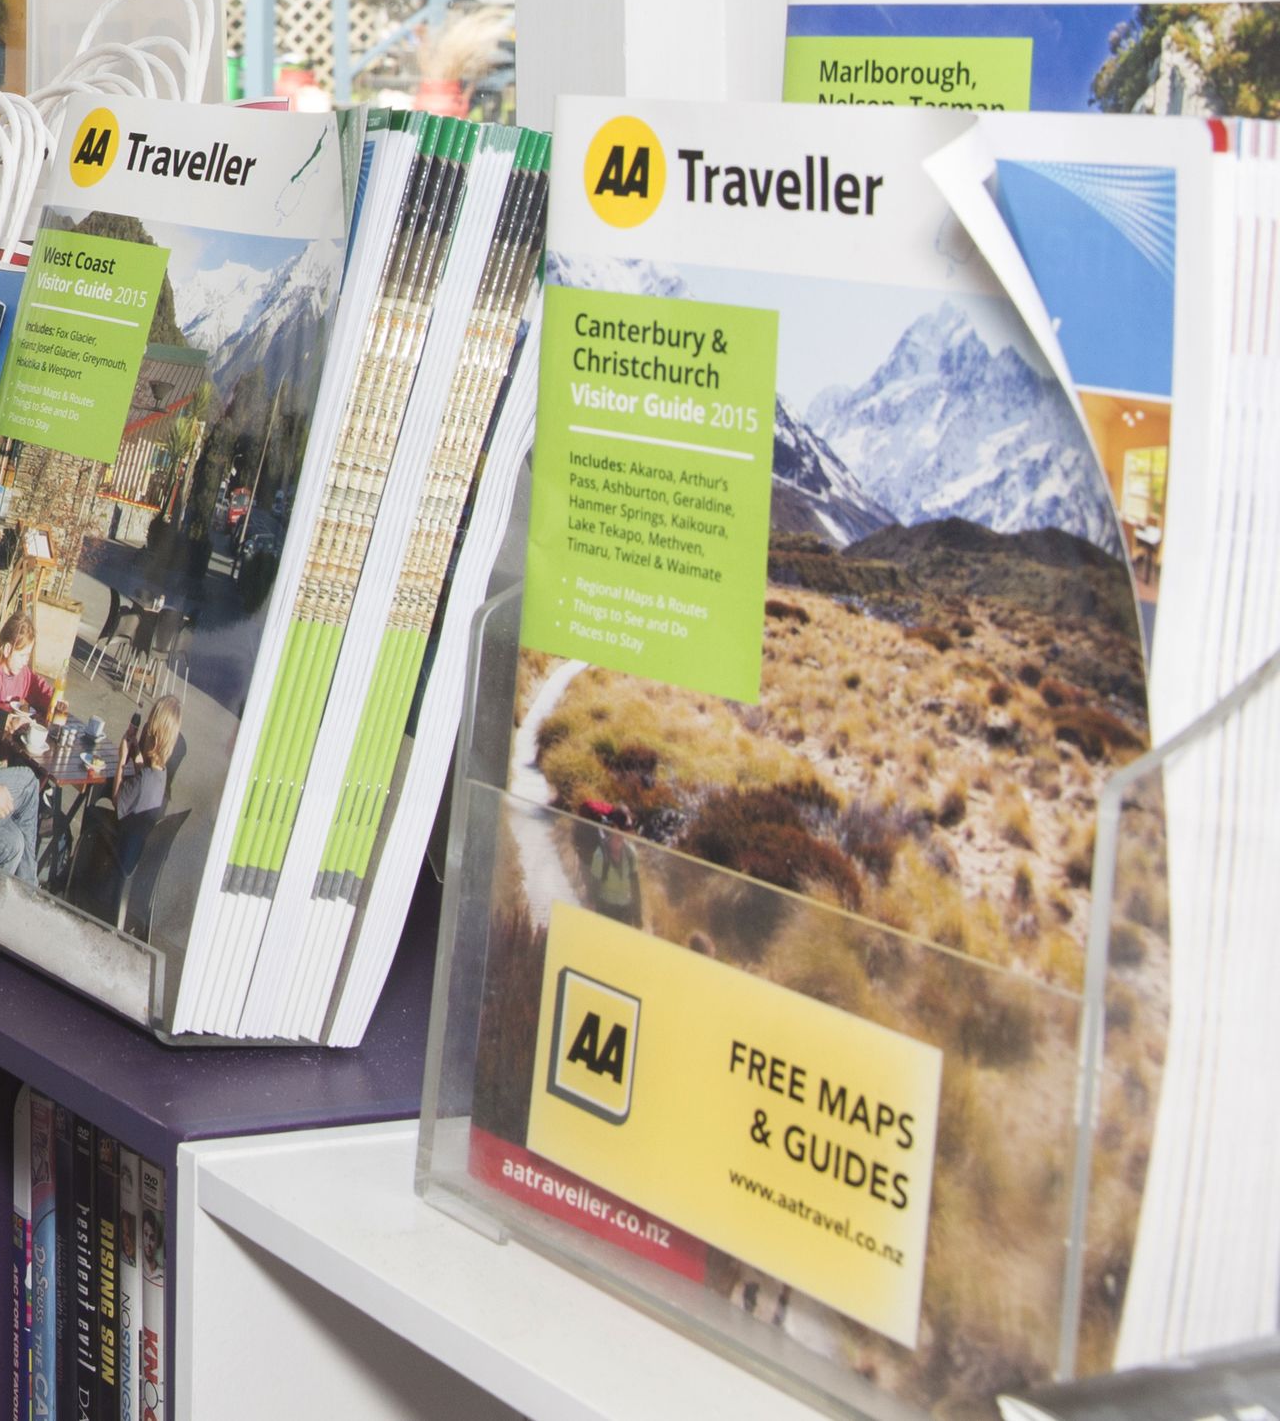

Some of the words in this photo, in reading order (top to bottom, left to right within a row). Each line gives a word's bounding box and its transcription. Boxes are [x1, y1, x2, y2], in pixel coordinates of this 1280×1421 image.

[819, 59, 977, 90] Marlborough,
[127, 132, 256, 186] Traveller
[679, 149, 883, 217] Traveller
[43, 246, 71, 267] West
[75, 251, 116, 275] Coast
[575, 313, 707, 355] Canterbury
[711, 327, 728, 355] &
[573, 348, 720, 390] Christchurch
[730, 1041, 806, 1101] FREE
[819, 1076, 914, 1149] MAPS
[749, 1110, 771, 1148] &
[783, 1126, 908, 1209] GUIDES
[729, 1168, 904, 1266] www.aatravel.co.nz
[100, 1219, 114, 1319] RISING
[100, 1330, 114, 1386] SUN
